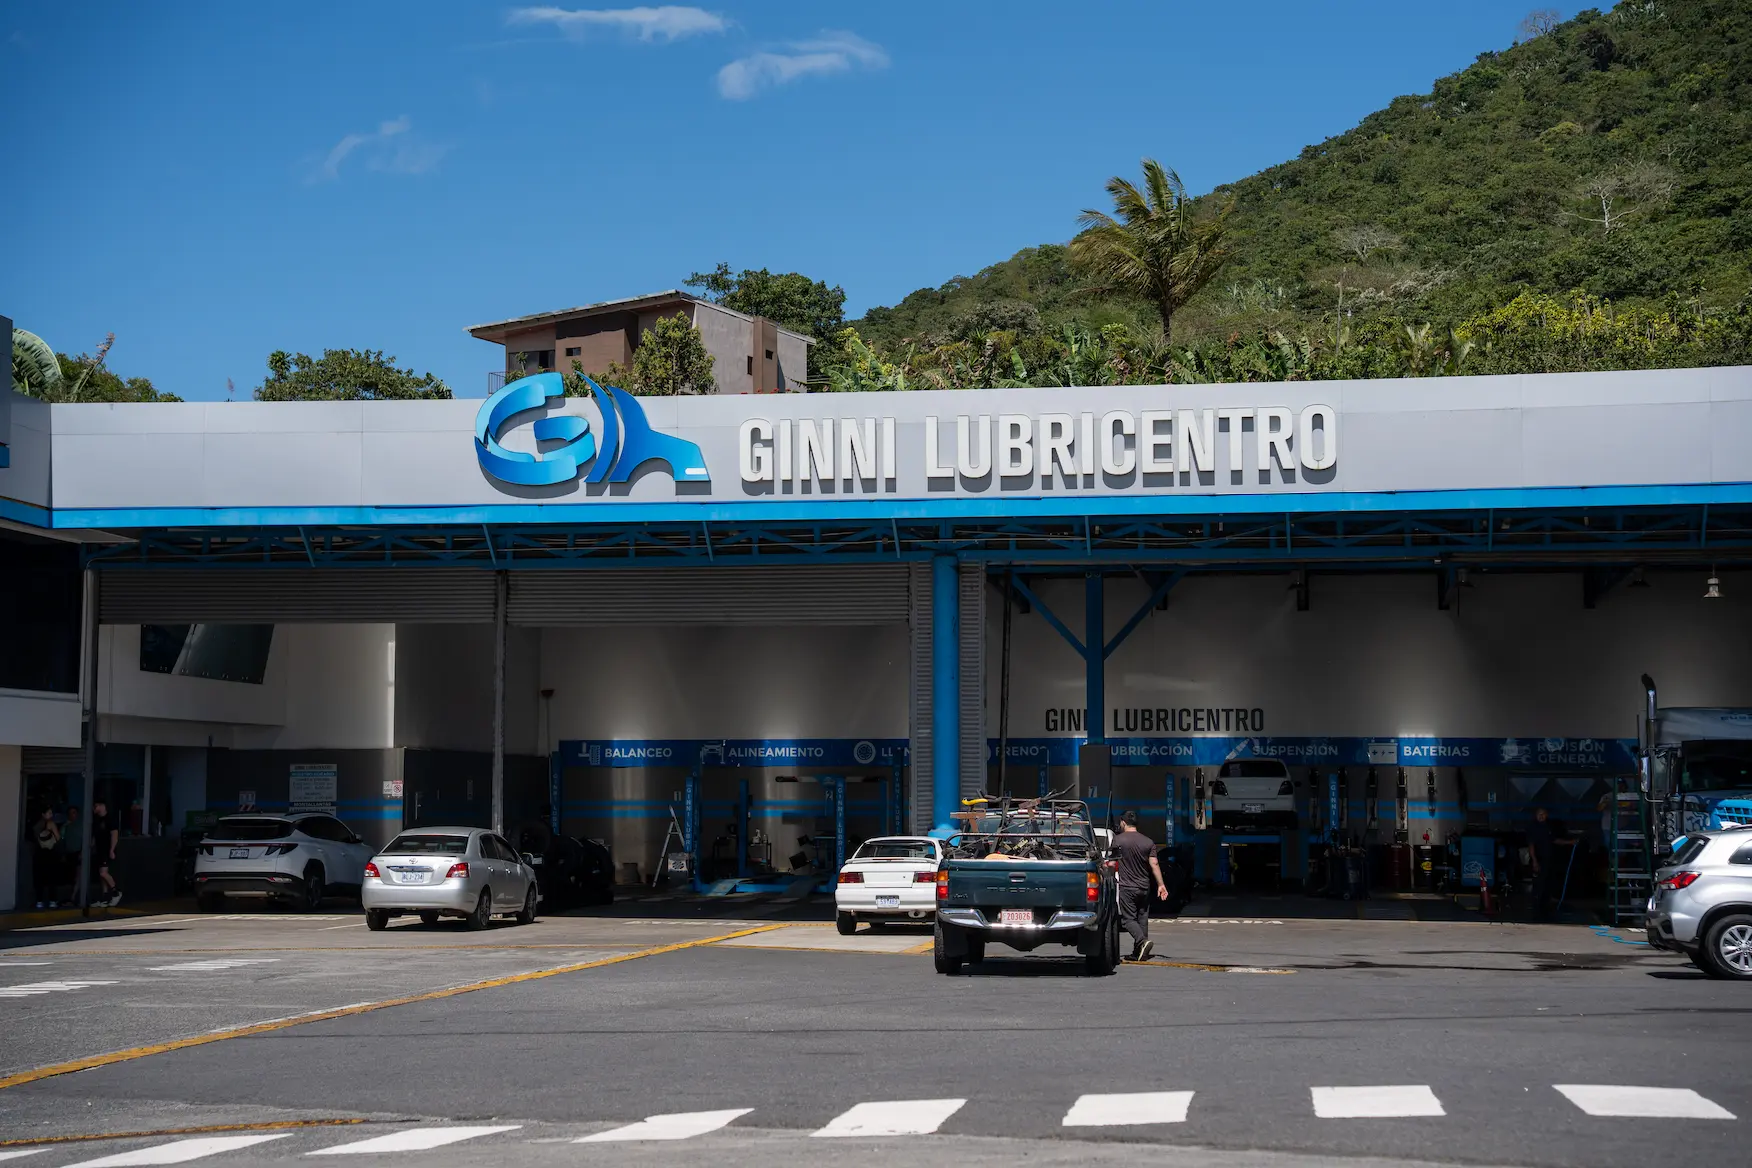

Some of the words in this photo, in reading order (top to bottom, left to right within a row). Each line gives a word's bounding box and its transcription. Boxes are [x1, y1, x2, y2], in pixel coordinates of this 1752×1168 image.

[740, 416, 896, 482] GINNI
[925, 403, 1337, 478] LUBRICENTRO
[1113, 708, 1264, 732] LUBRICENTRO
[605, 747, 672, 758] BALANCEO
[728, 747, 824, 758] ALINEAMIENTO
[1403, 745, 1470, 757] BATERIAS
[1537, 753, 1605, 764] GENERAL
[1007, 912, 1031, 921] 203026
